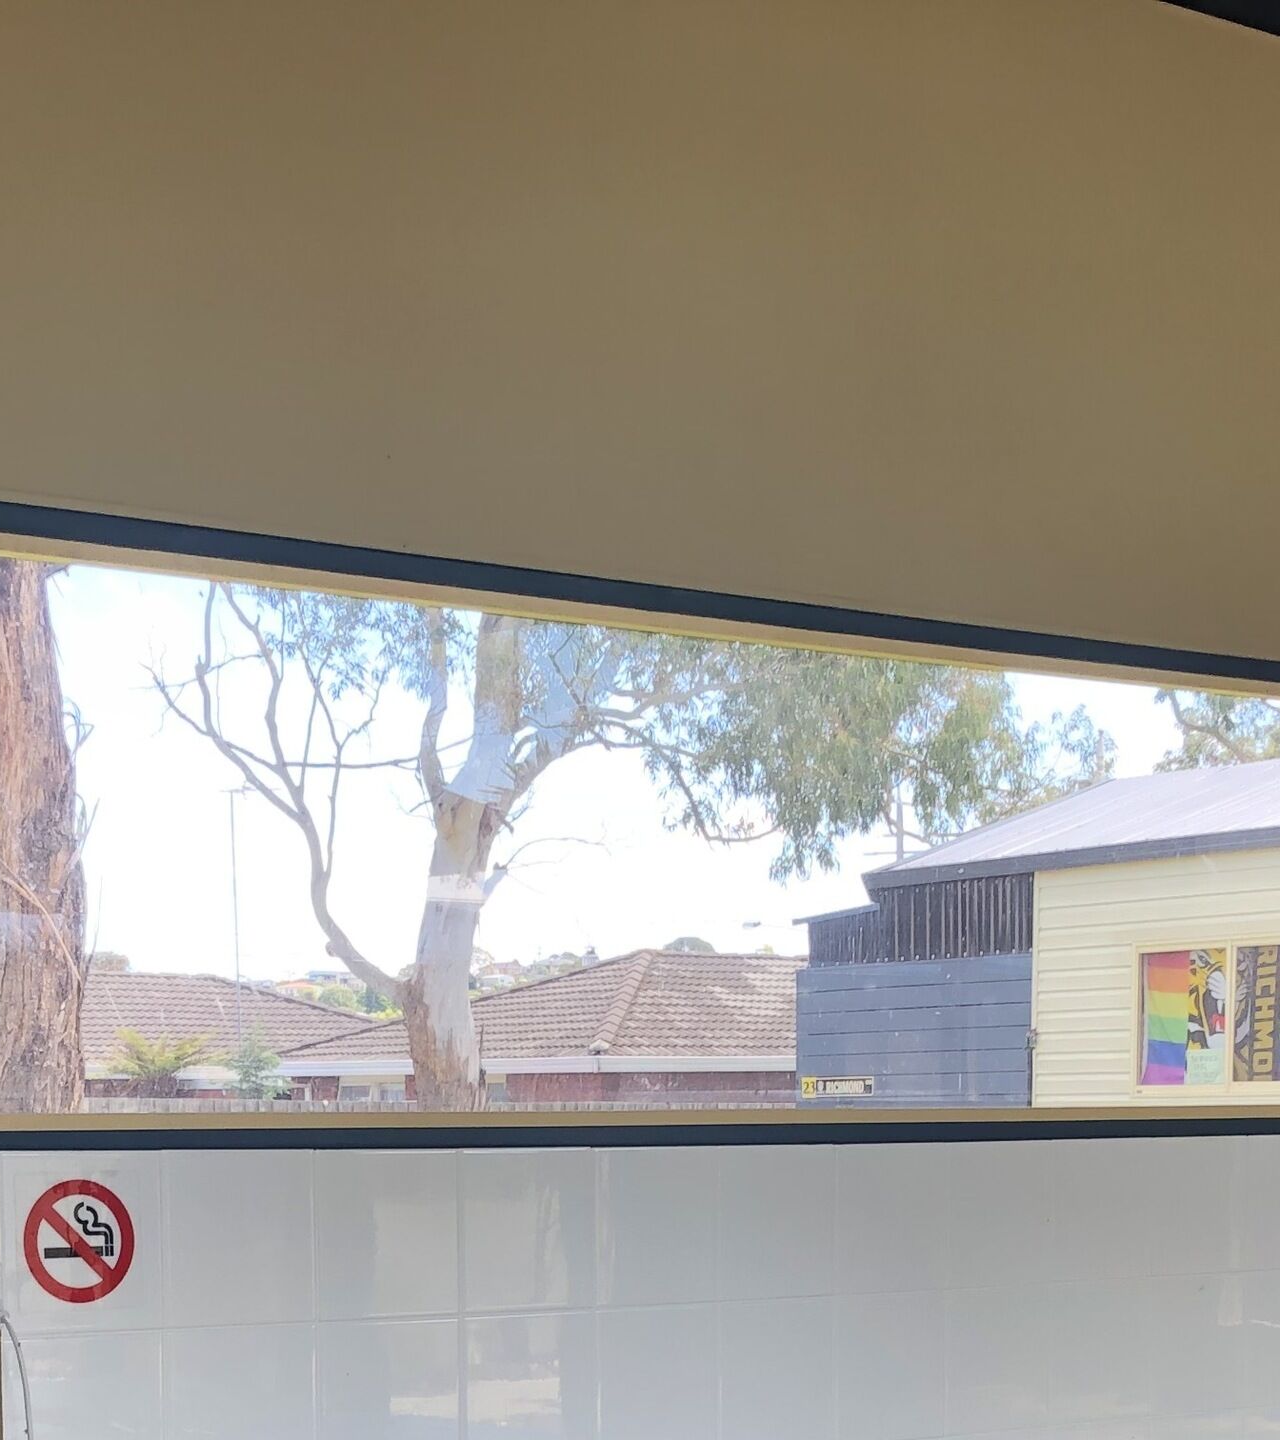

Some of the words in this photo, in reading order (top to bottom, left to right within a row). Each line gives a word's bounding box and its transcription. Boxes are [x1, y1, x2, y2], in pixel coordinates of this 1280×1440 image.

[1252, 945, 1279, 1080] RICHMO
[803, 1081, 816, 1094] 23
[825, 1080, 865, 1094] RICHMOND
